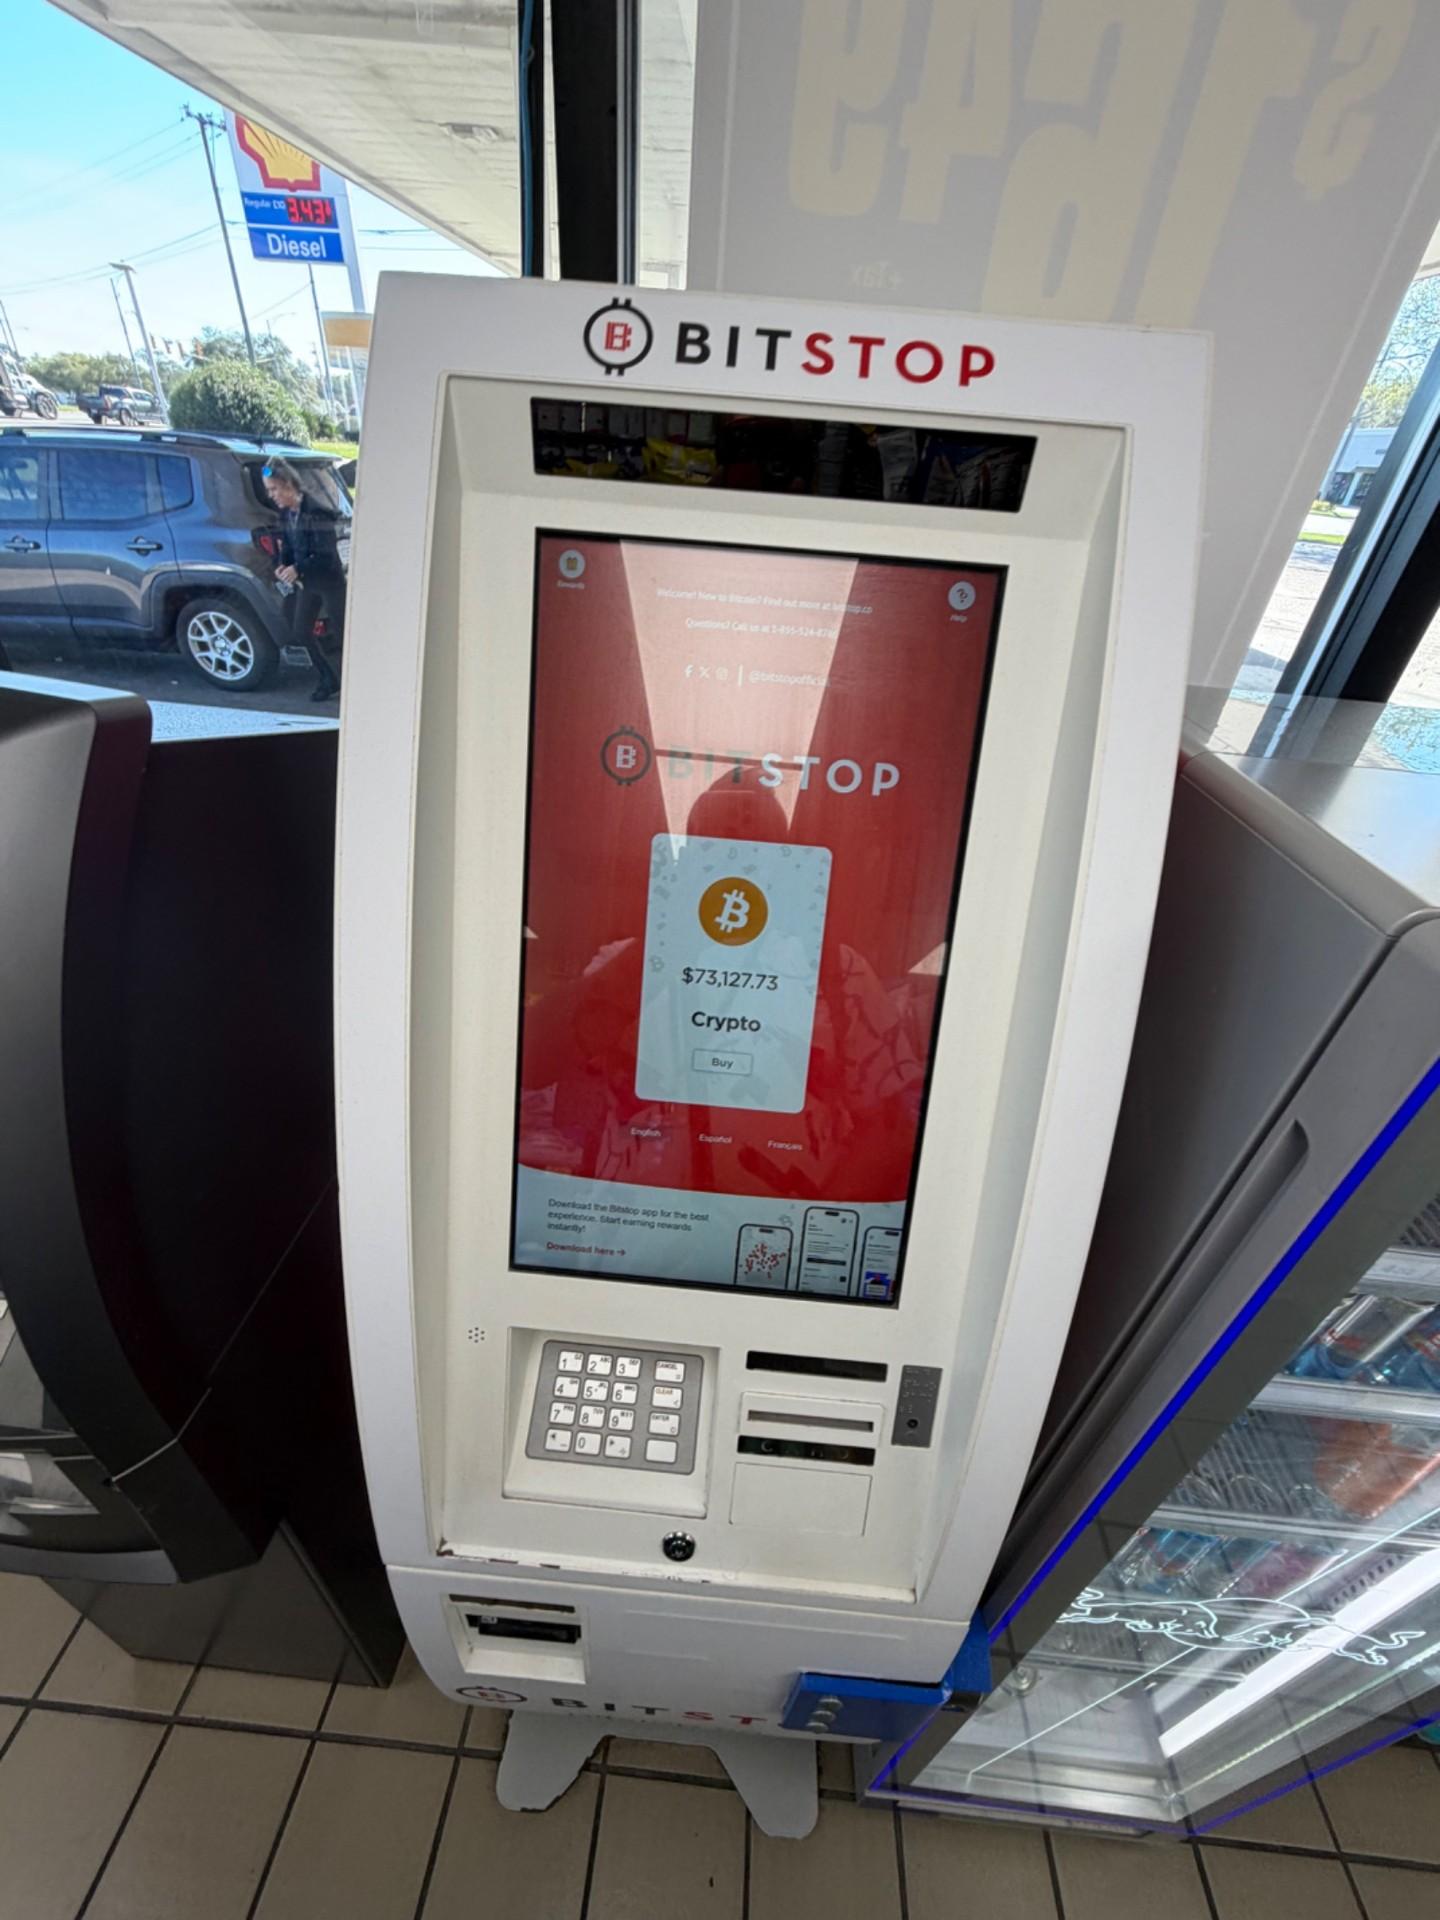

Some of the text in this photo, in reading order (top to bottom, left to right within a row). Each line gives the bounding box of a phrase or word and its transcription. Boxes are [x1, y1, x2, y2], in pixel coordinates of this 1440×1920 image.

[266, 232, 327, 258] Diesel
[675, 321, 996, 387] BITSTOP
[668, 744, 900, 797] BITSTOP
[681, 966, 779, 991] $73,127.73
[691, 1011, 761, 1033] Crypto
[711, 1057, 734, 1070] Buy
[630, 1127, 661, 1139] English
[548, 1198, 709, 1222] Download the Bitstop app for the best
[547, 1211, 692, 1232] experience. Start earning rewards
[547, 1221, 587, 1234] instantly!
[546, 1241, 614, 1256] Download here
[589, 1361, 598, 1372] 2
[618, 1363, 626, 1375] 3
[657, 1362, 678, 1370] CANCEL
[556, 1383, 564, 1394] 4
[585, 1386, 593, 1398] 5
[655, 1388, 674, 1396] CLEAR
[614, 1389, 623, 1401] 6
[553, 1409, 561, 1421] 7
[581, 1412, 589, 1424] 8
[611, 1416, 620, 1427] 9
[551, 1697, 768, 1725] BITST
